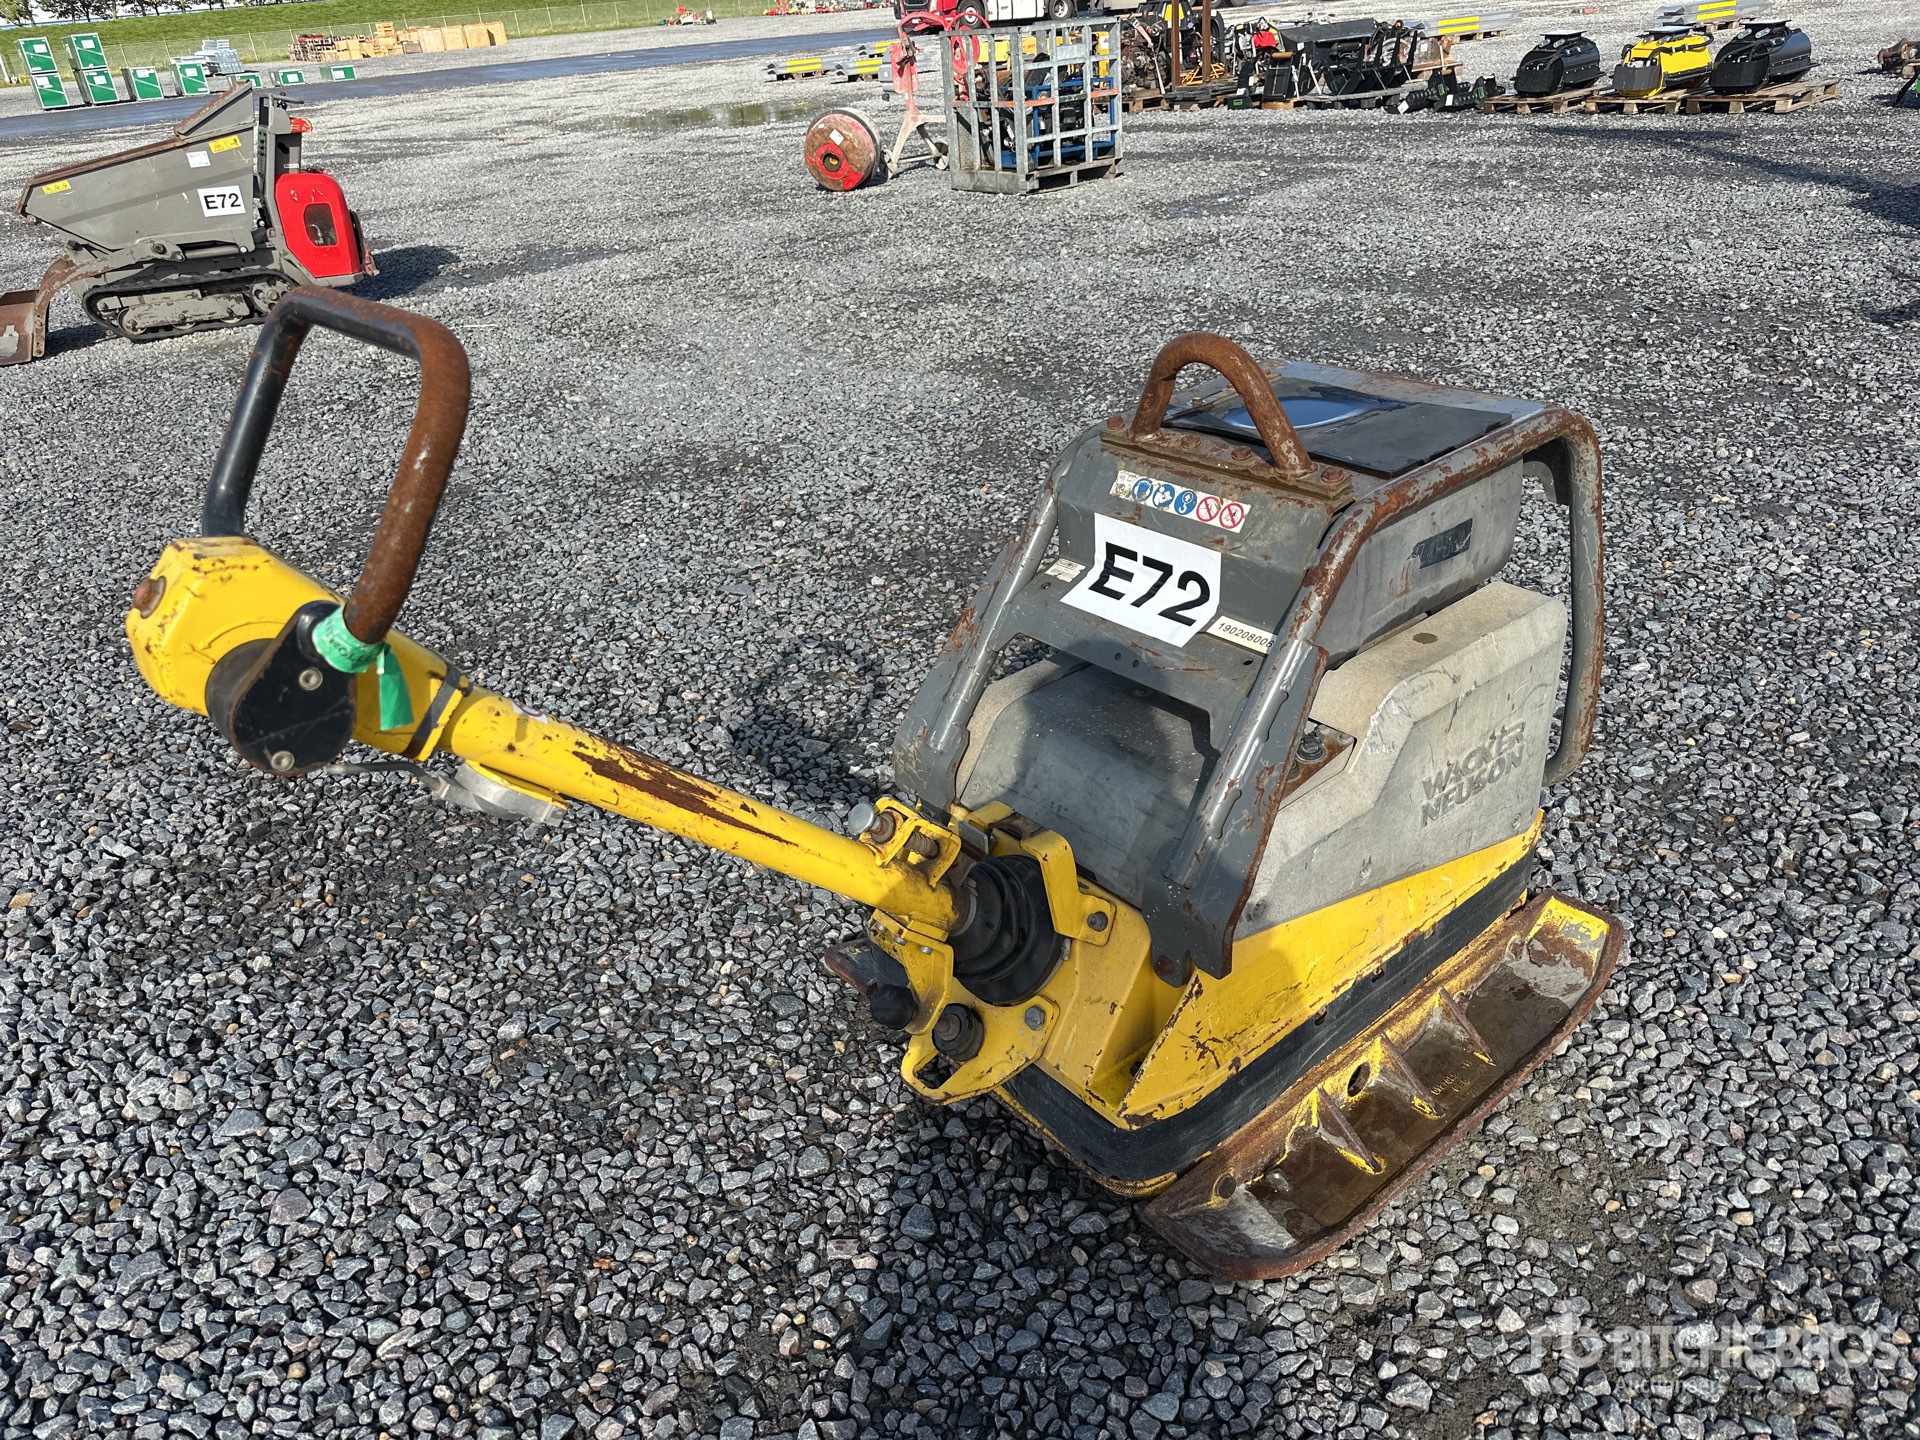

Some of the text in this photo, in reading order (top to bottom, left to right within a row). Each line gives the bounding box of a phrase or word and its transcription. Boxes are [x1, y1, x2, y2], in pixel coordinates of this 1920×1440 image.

[203, 192, 241, 210] E72
[1088, 541, 1210, 627] E72
[1217, 622, 1275, 648] 190208006
[1421, 719, 1525, 801] WACKER
[1421, 742, 1524, 827] NEUSON
